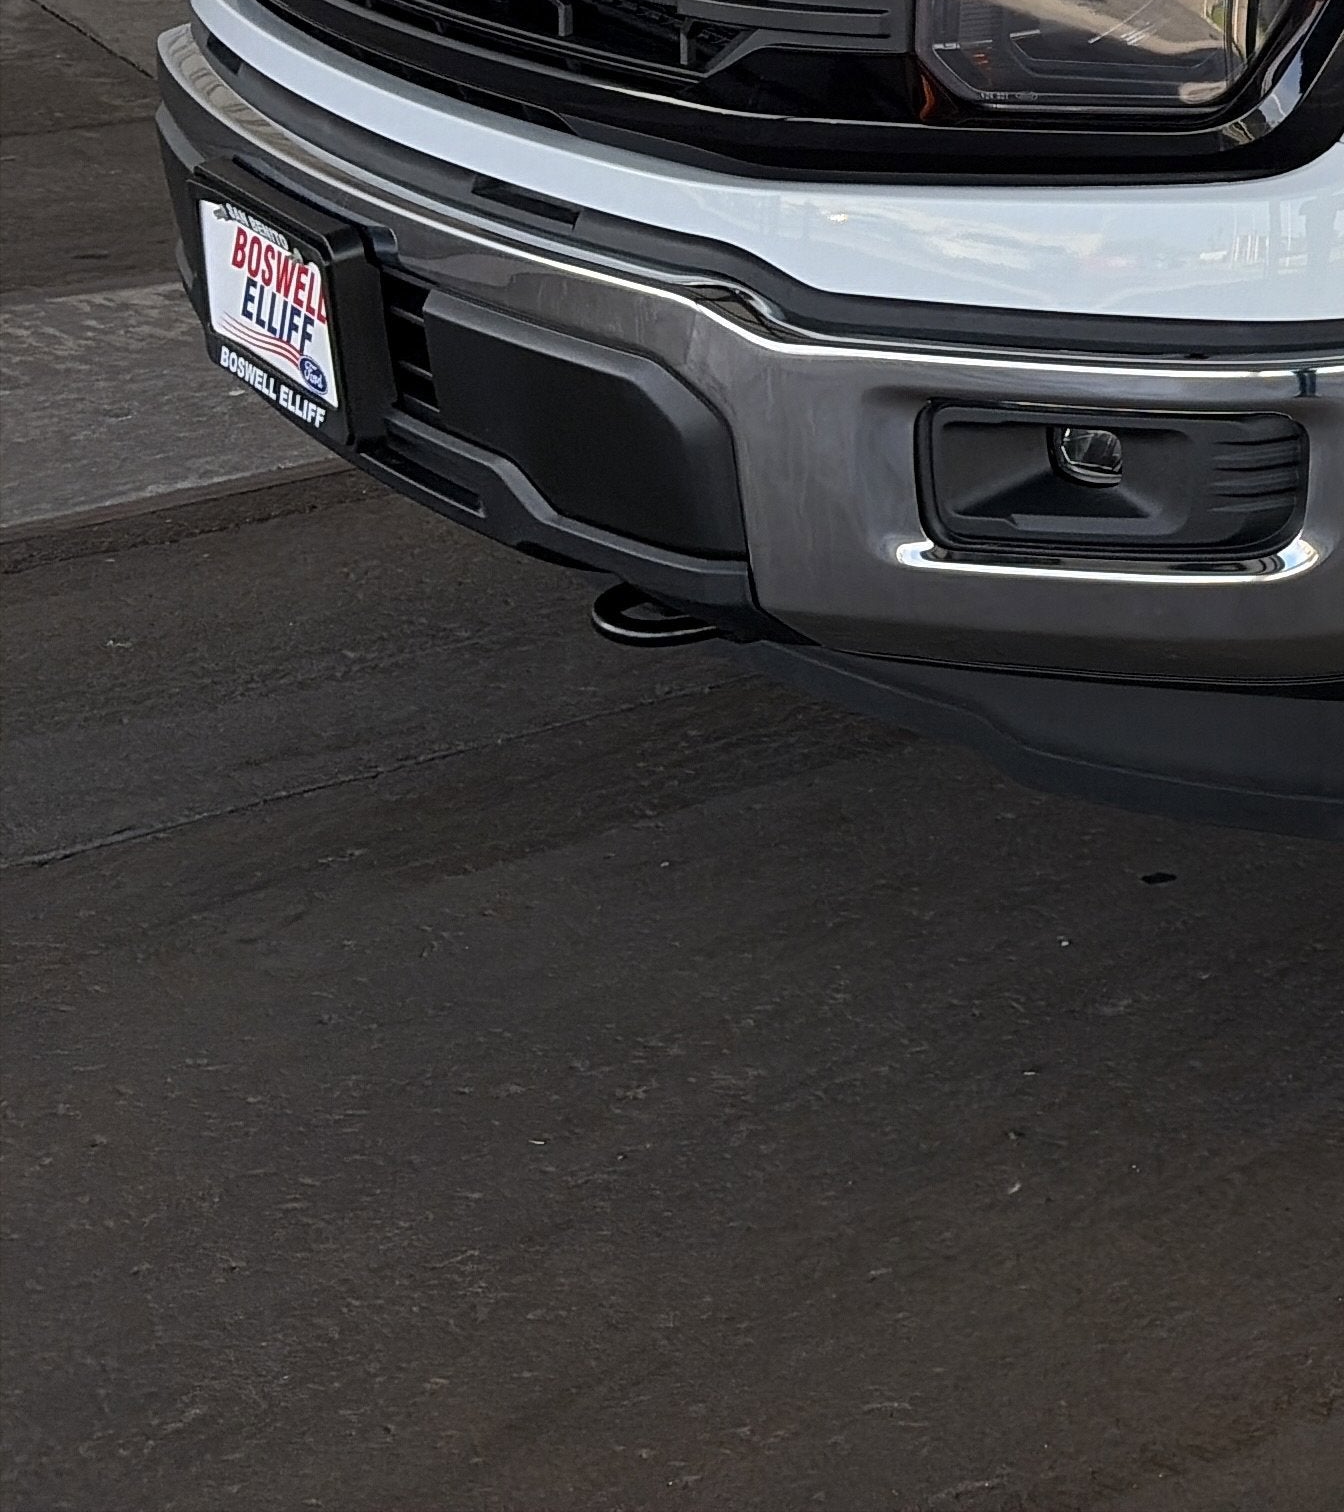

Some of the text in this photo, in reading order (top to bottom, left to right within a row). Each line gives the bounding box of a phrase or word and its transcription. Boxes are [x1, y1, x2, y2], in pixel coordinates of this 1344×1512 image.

[231, 226, 328, 325] BOSWELL
[241, 276, 315, 355] ELLIFF
[220, 345, 326, 428] BOSWELL ELLIFF
[302, 358, 325, 392] Ford
